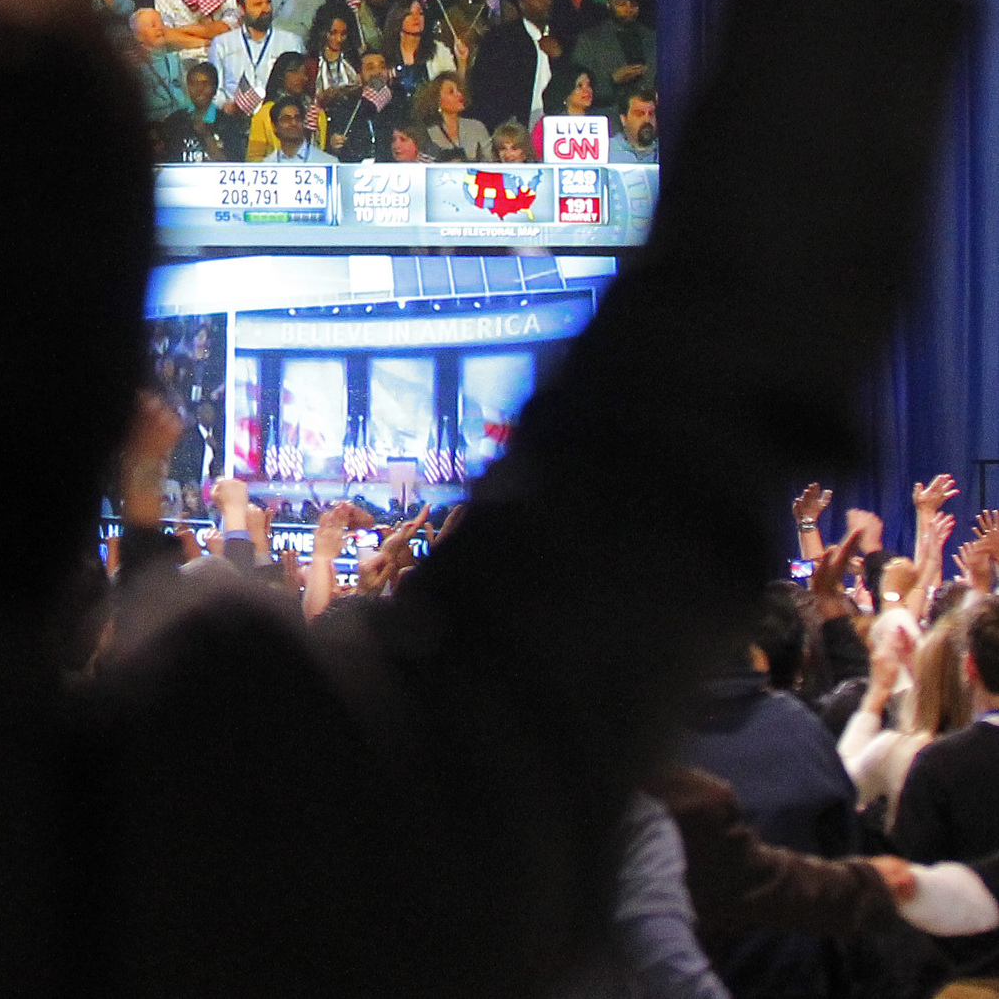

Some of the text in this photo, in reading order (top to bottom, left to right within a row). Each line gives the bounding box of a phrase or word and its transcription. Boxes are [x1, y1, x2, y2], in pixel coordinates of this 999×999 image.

[556, 122, 599, 134] LIVE
[553, 137, 599, 160] CNN
[219, 169, 278, 187] 244,752
[353, 168, 411, 193] 270
[561, 169, 597, 185] 249
[221, 189, 279, 207] 208,791
[353, 192, 410, 207] NEEDED
[565, 198, 594, 213] 191
[354, 206, 410, 222] TO WIN
[281, 313, 542, 344] BELIEVE IN AMERICA
